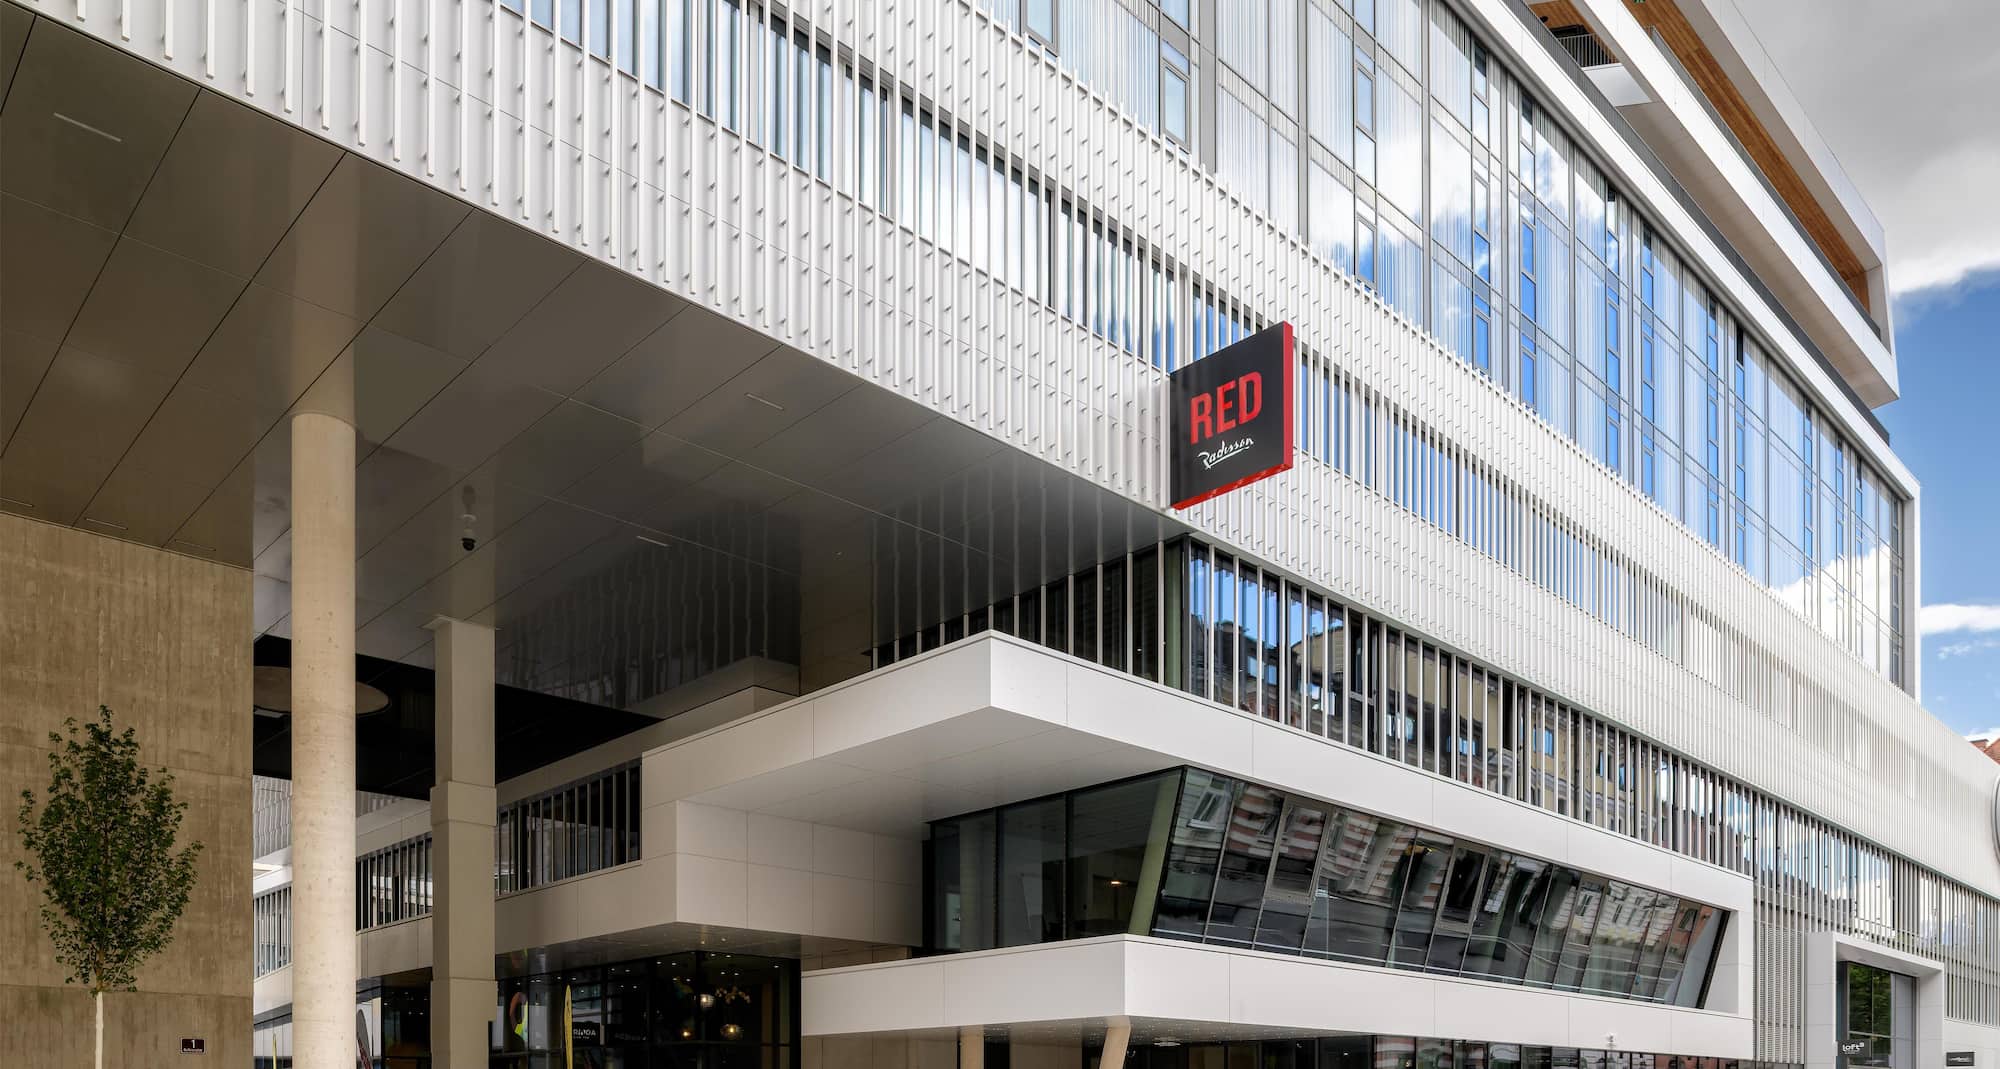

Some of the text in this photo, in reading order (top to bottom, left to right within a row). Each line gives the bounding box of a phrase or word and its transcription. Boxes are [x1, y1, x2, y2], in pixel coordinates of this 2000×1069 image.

[1190, 371, 1263, 445] RED
[1197, 437, 1254, 470] Radisson
[191, 1039, 196, 1049] 1
